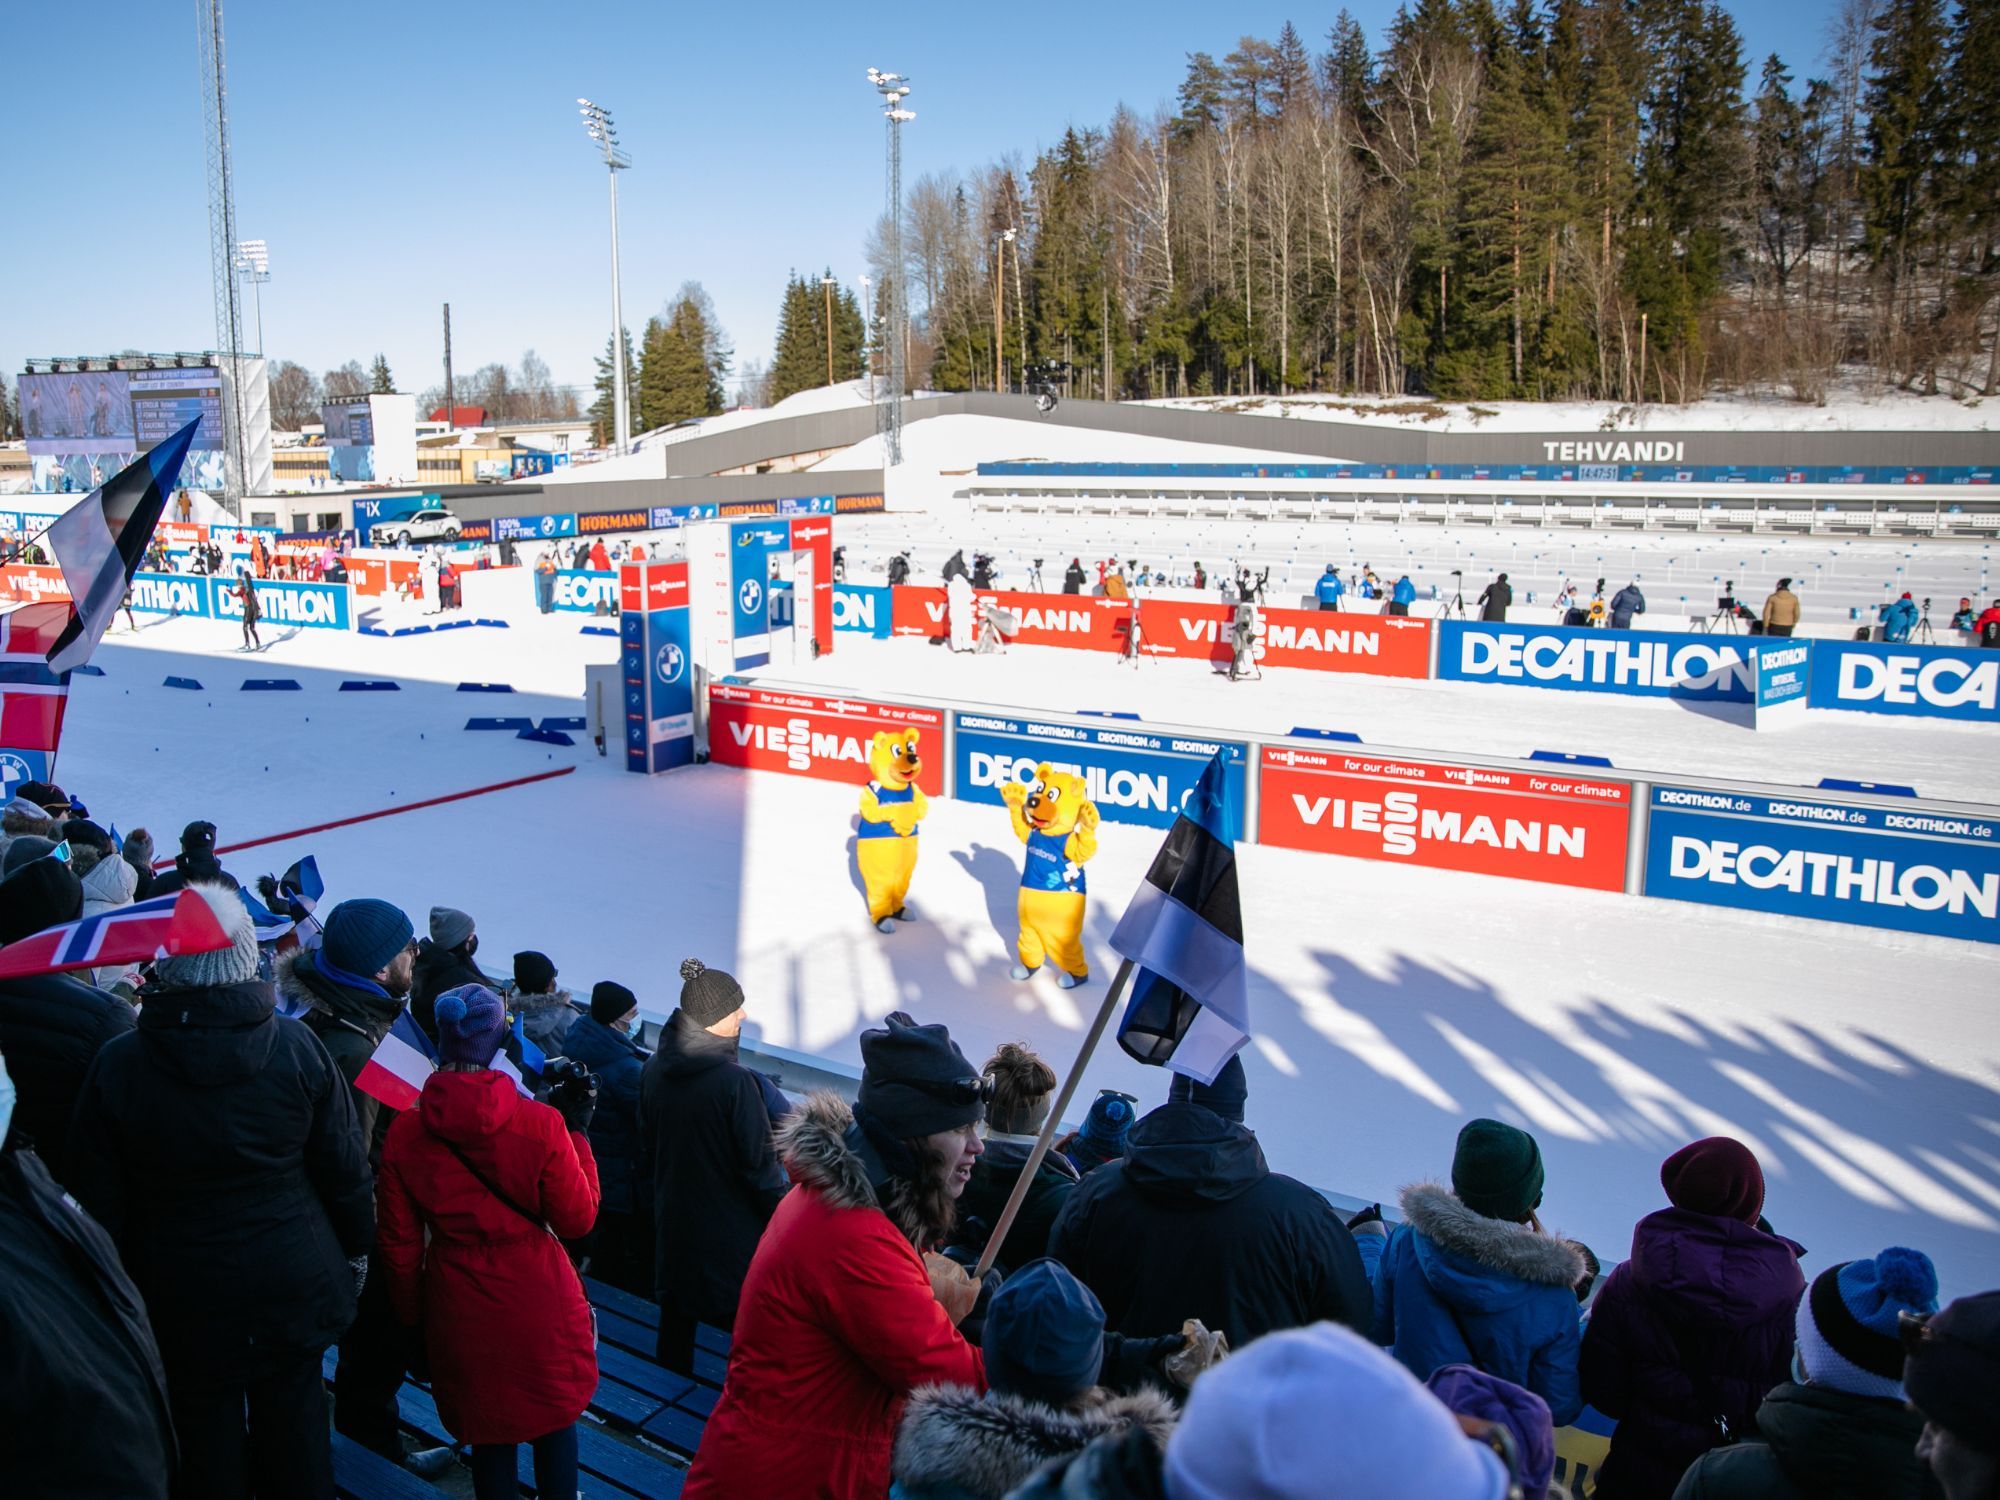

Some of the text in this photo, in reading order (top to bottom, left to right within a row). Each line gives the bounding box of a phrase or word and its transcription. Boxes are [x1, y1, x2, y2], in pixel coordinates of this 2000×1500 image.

[1543, 441, 1684, 462] TEHVANDI
[1580, 466, 1617, 479] 14:47:51
[459, 527, 490, 539] MANN
[131, 579, 199, 612] ATHLON
[1461, 631, 1756, 693] DECATHLON
[761, 693, 771, 702] for
[772, 697, 785, 705] our
[786, 696, 813, 708] climate
[825, 700, 867, 714] VIESSMANN
[879, 707, 890, 718] for
[892, 711, 905, 720] our
[907, 711, 937, 723] climate
[729, 718, 873, 770] VIESSMA
[960, 716, 1239, 757] DECATHLON.de DECATHLON.de DECATHLON.de DECATHLOe
[1268, 750, 1621, 799] VIESSMANN for our climate VIESSMANN for our climate
[1292, 791, 1586, 858] VIESSMANN
[1660, 790, 1992, 838] DECATHLON.de DECATHLON.de DECATHLON.de
[1669, 835, 2000, 919] DECATHLON
